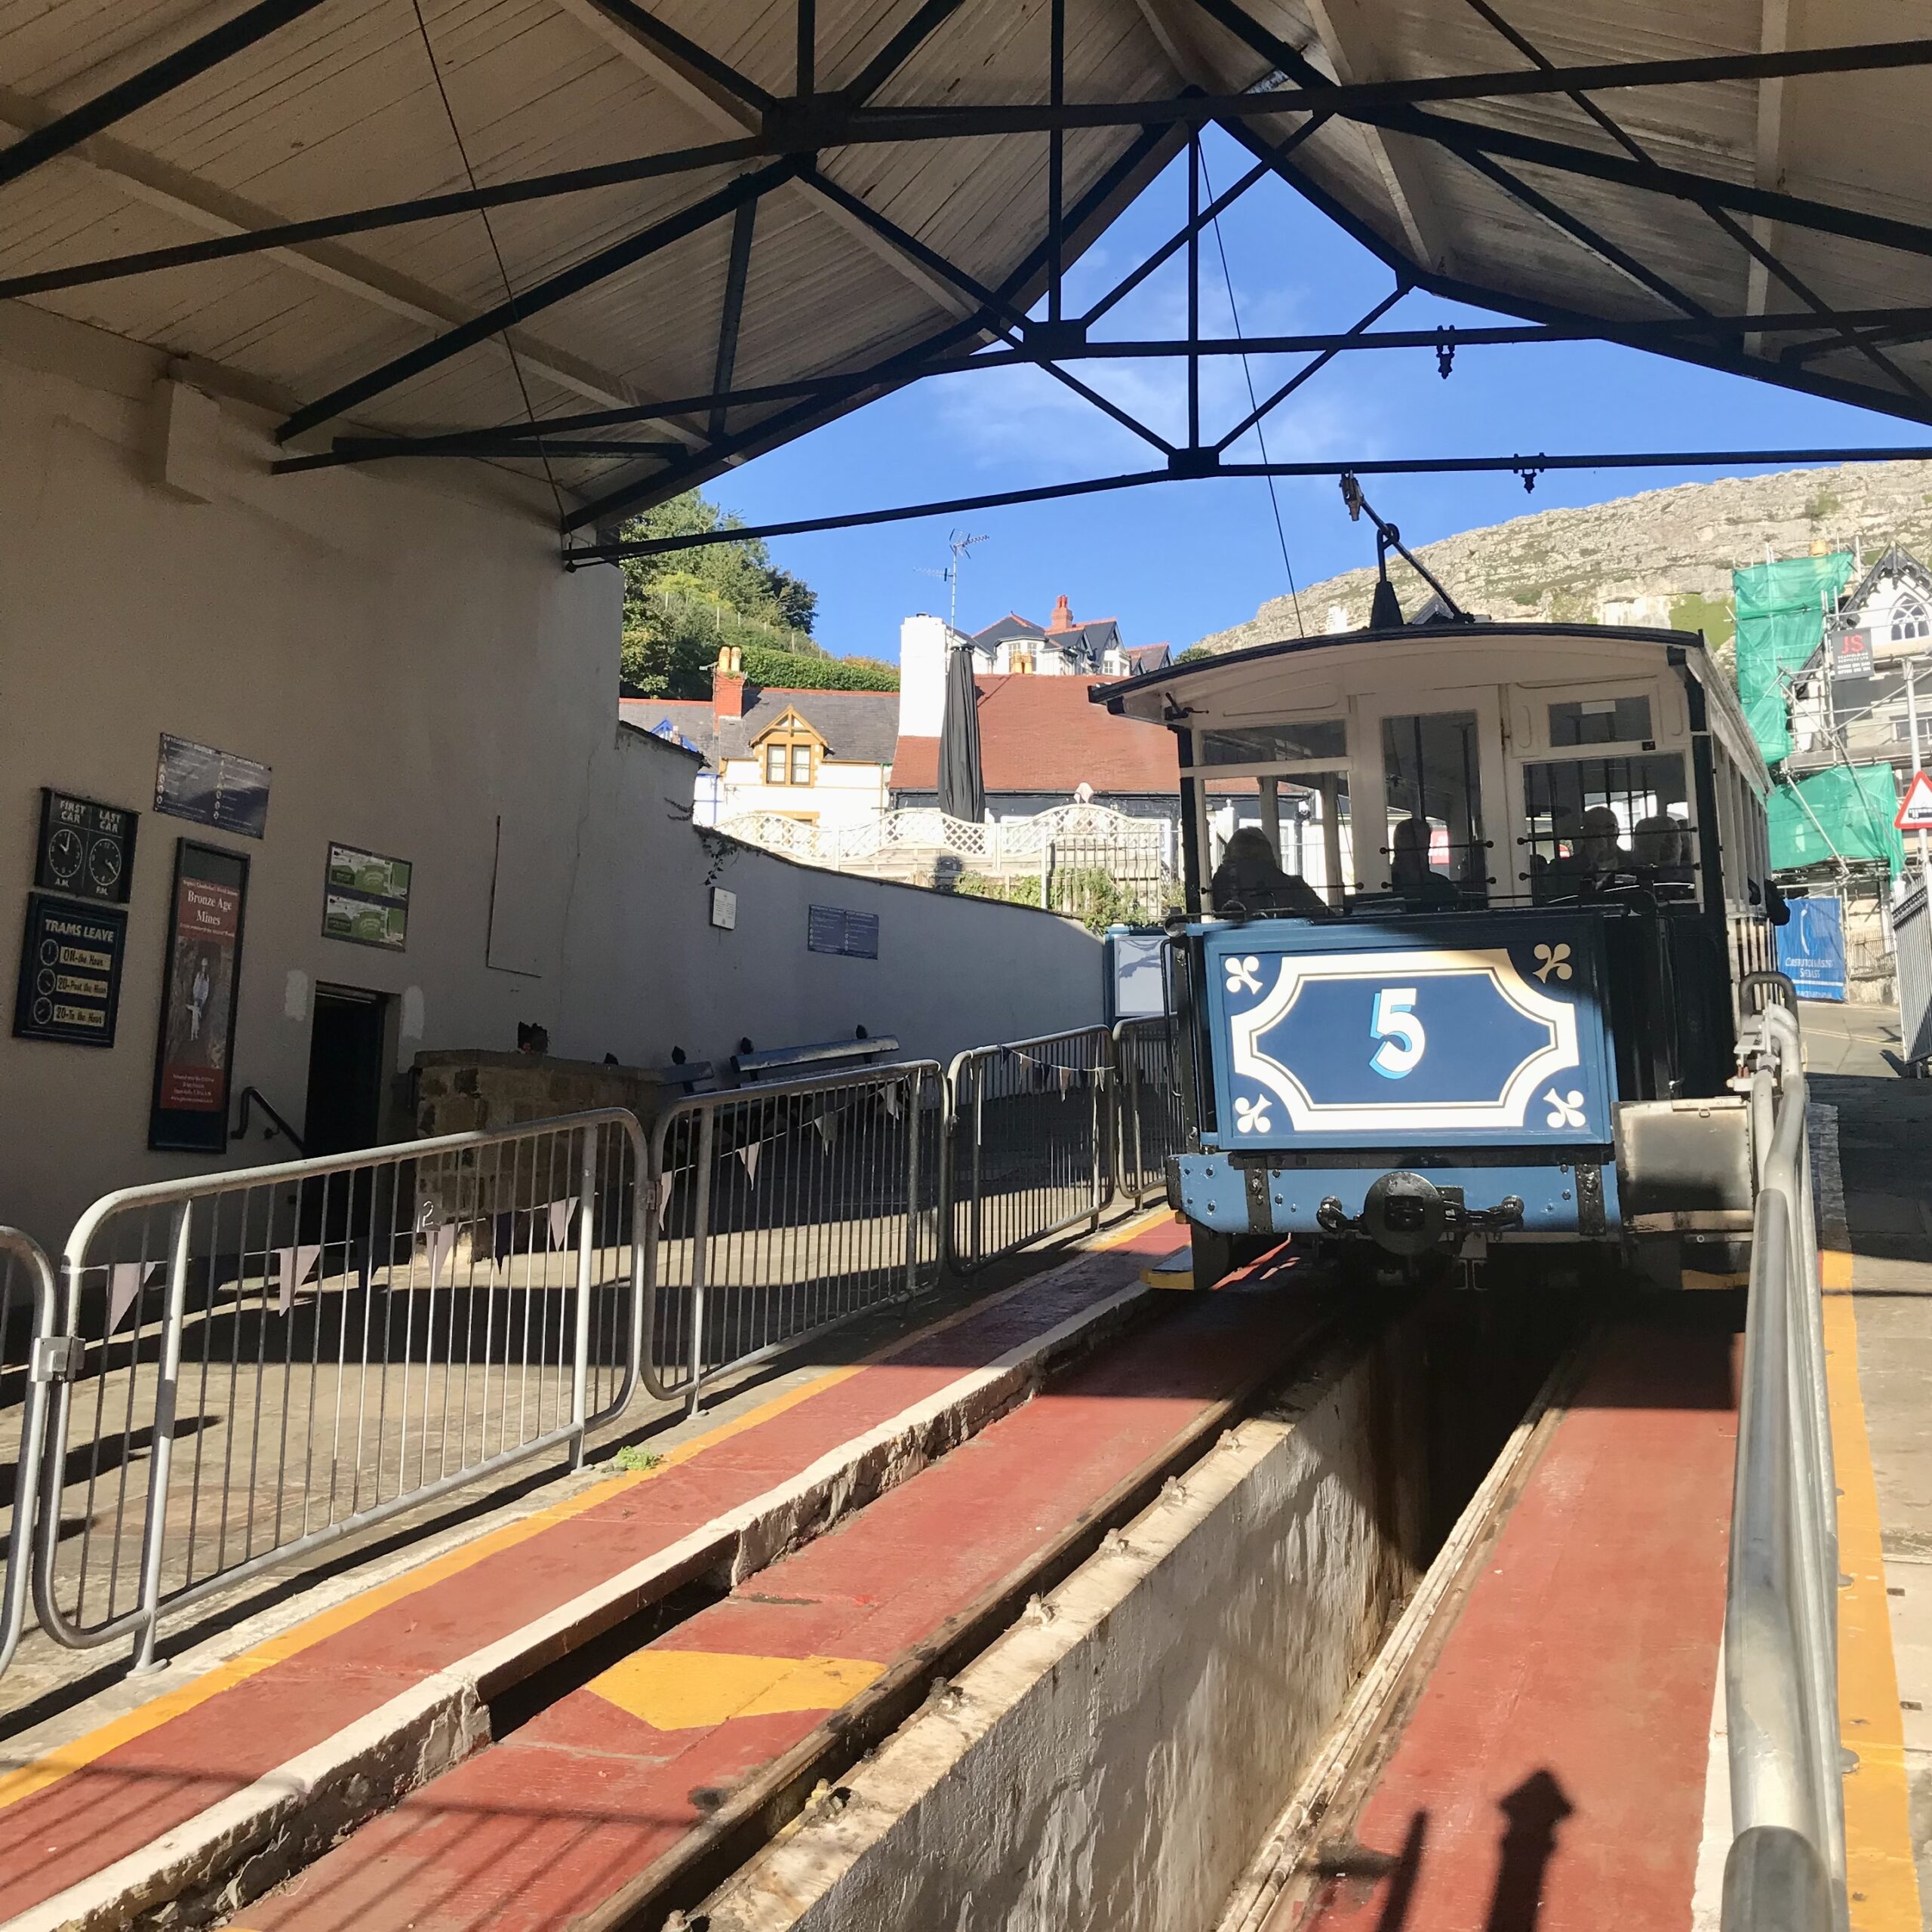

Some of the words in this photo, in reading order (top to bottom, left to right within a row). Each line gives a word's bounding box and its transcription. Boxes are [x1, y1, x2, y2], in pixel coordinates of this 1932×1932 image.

[1841, 634, 1864, 654] JS
[60, 801, 86, 814] FIRST
[61, 811, 80, 824] CAR
[100, 810, 121, 823] LAST
[100, 820, 118, 833] CAR
[188, 891, 216, 907] Bronze
[218, 897, 232, 912] Age
[196, 910, 220, 925] Mines
[45, 918, 82, 937] TRAMS
[84, 927, 114, 943] LEAVE
[1369, 988, 1425, 1079] 5
[423, 1201, 434, 1227] 2
